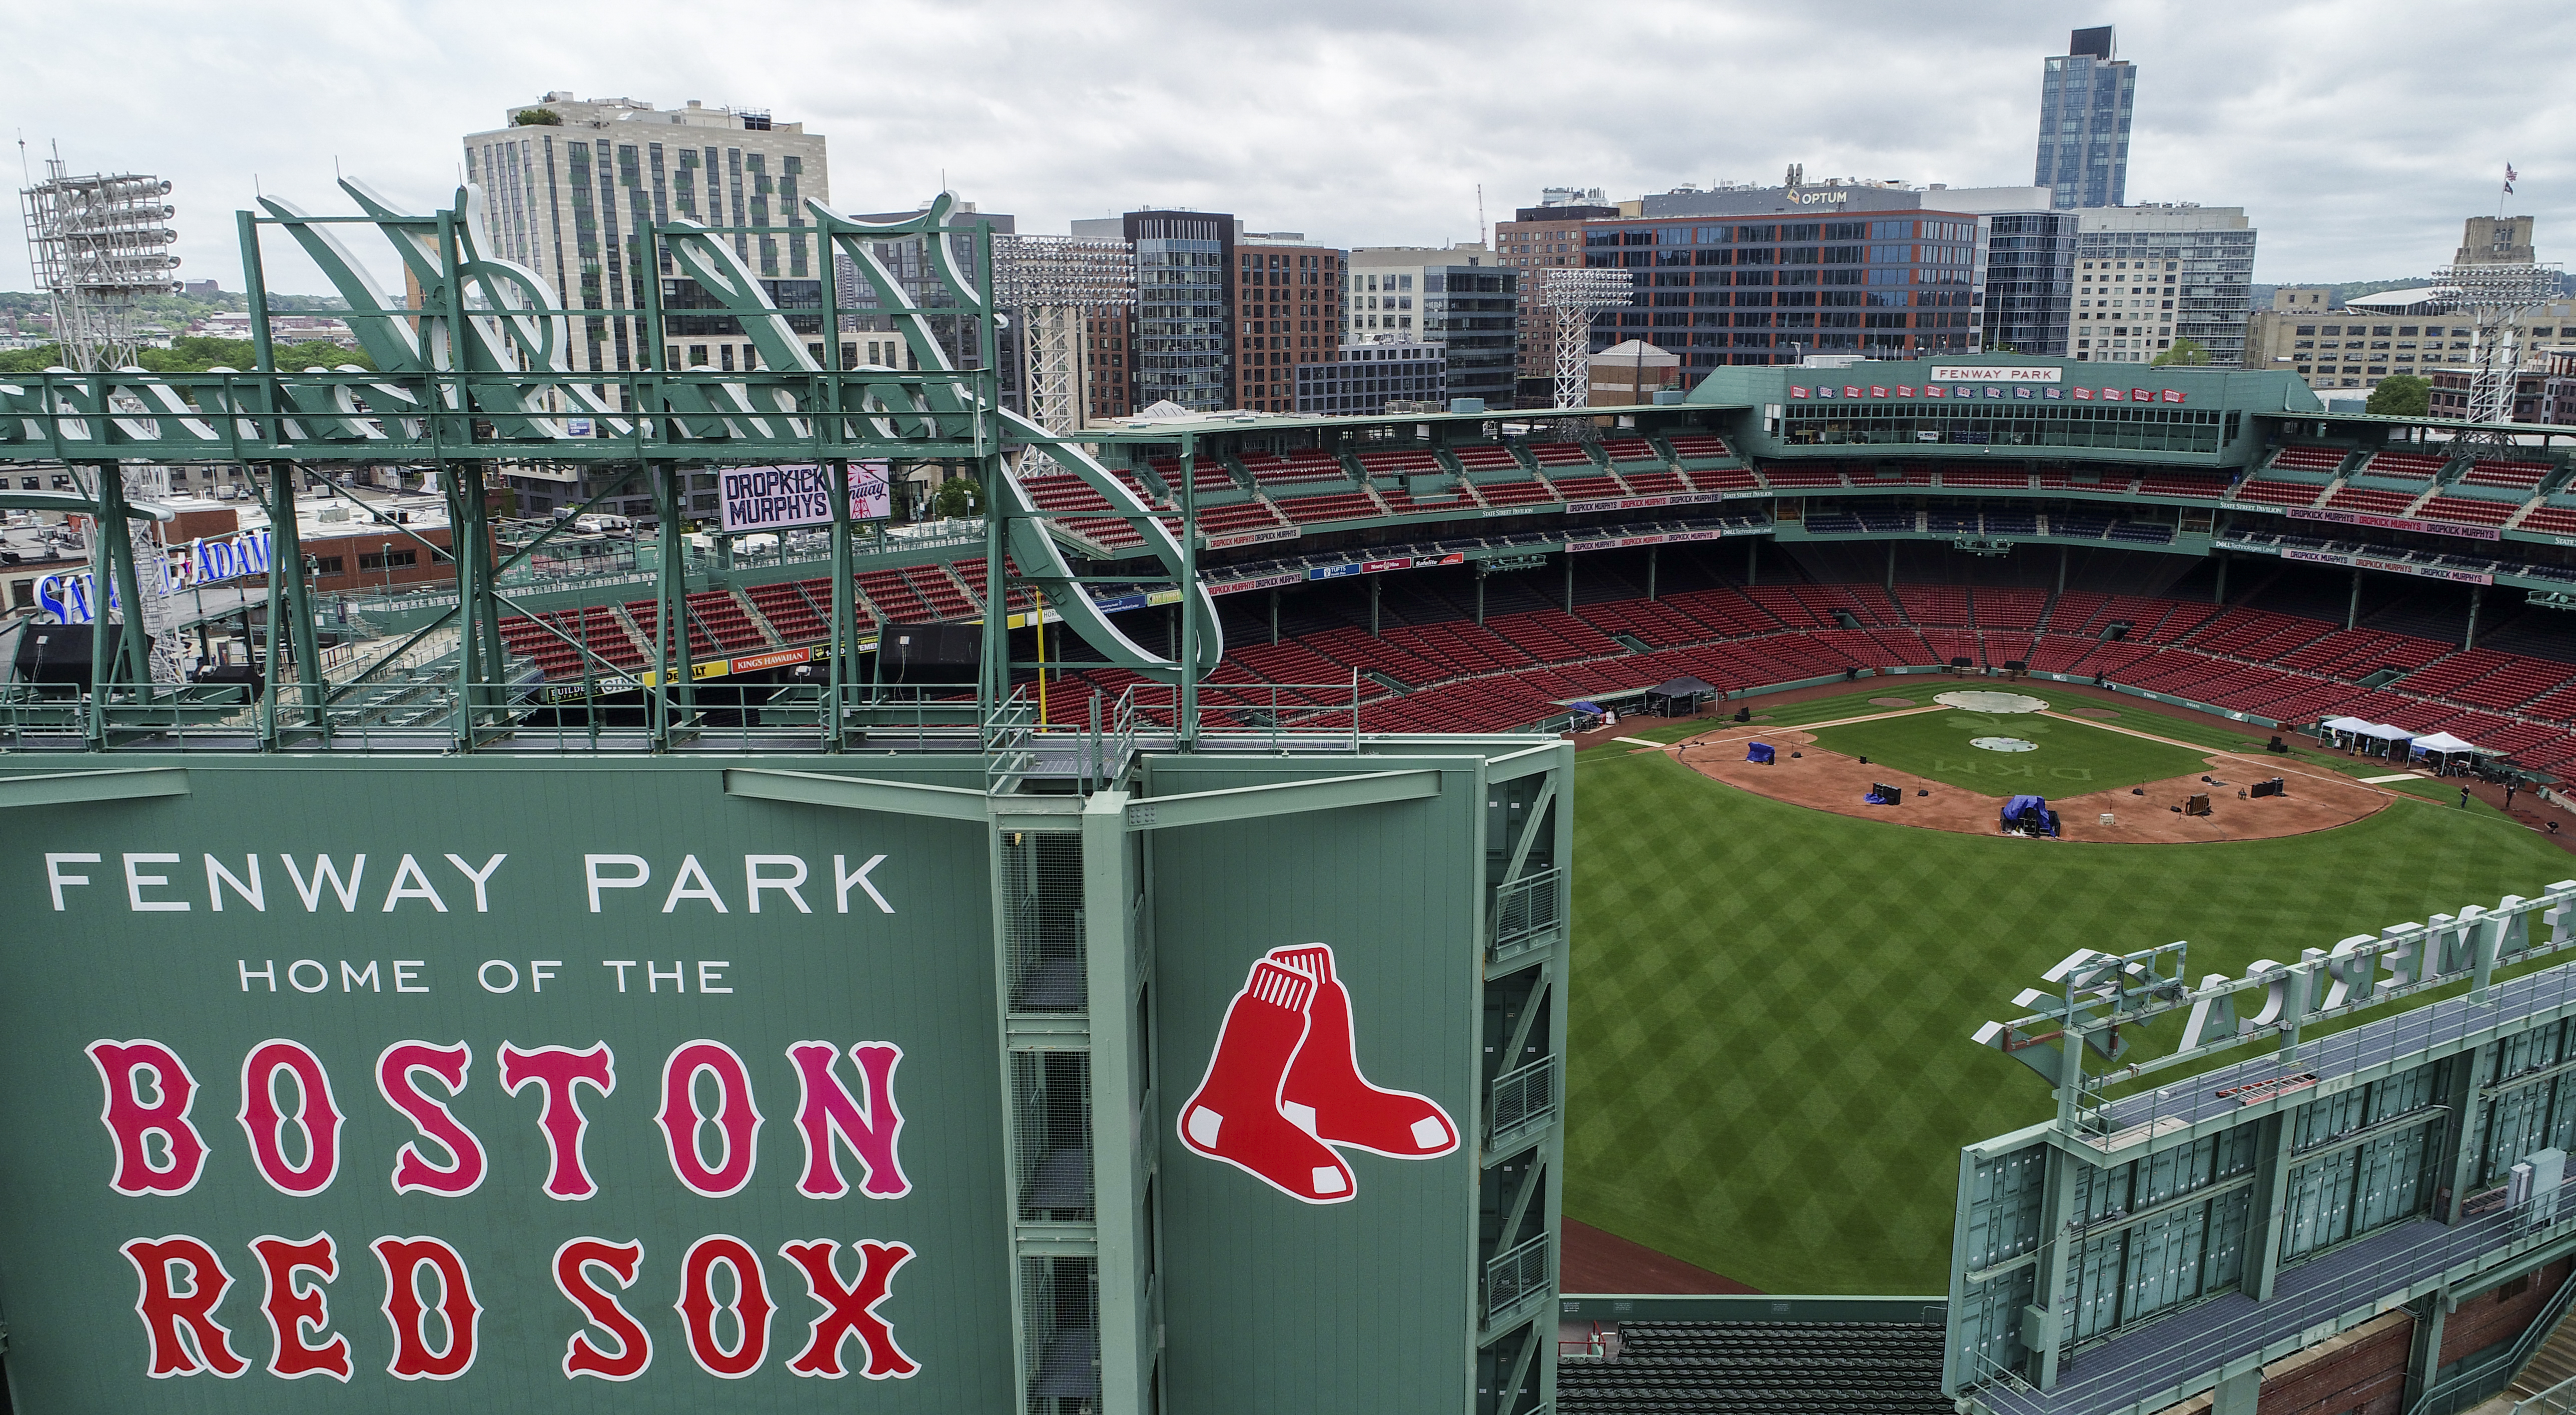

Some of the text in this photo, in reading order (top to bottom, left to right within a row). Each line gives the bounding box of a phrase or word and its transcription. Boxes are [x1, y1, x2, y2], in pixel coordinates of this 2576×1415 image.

[1802, 192, 1847, 204] OPTUM
[1940, 369, 2053, 380] FENWAY PARK
[725, 468, 827, 500] DROPKICK
[849, 482, 887, 501] nway
[729, 492, 826, 526] MURPHYS
[1570, 493, 1718, 512] DROPKICK MURPHYS DROPKICK MURPHYS DROPKICK MURPHYS
[2255, 505, 2282, 514] PAVILION
[2291, 509, 2494, 539] DROPKICK MURPHYS DROPKICK MURPHYS DROPKICK MURPHYS
[1211, 529, 1297, 547] DROPKICK MURPHYS DROPKICK MURPHYS
[1572, 531, 1713, 550] DROPKICK MURPHYS DROPKICK MURPHYS DROPKICK MURPHYS
[188, 533, 287, 584] ADAM
[2290, 551, 2482, 582] DROPKICK MURPHYS DROPKICK MURPHYS DROPKICK MURPHYS
[1207, 573, 1301, 595] DROPKICK MURPHYS DROPKICK MURPHYS
[737, 651, 803, 669] KING'S HAWAIIAN
[667, 665, 706, 681] DEALT
[44, 852, 896, 914] FENWAY PARK
[237, 958, 734, 995] HOME OF THE
[84, 1037, 914, 1202] BOSTON
[119, 1230, 924, 1384] RED SOX
